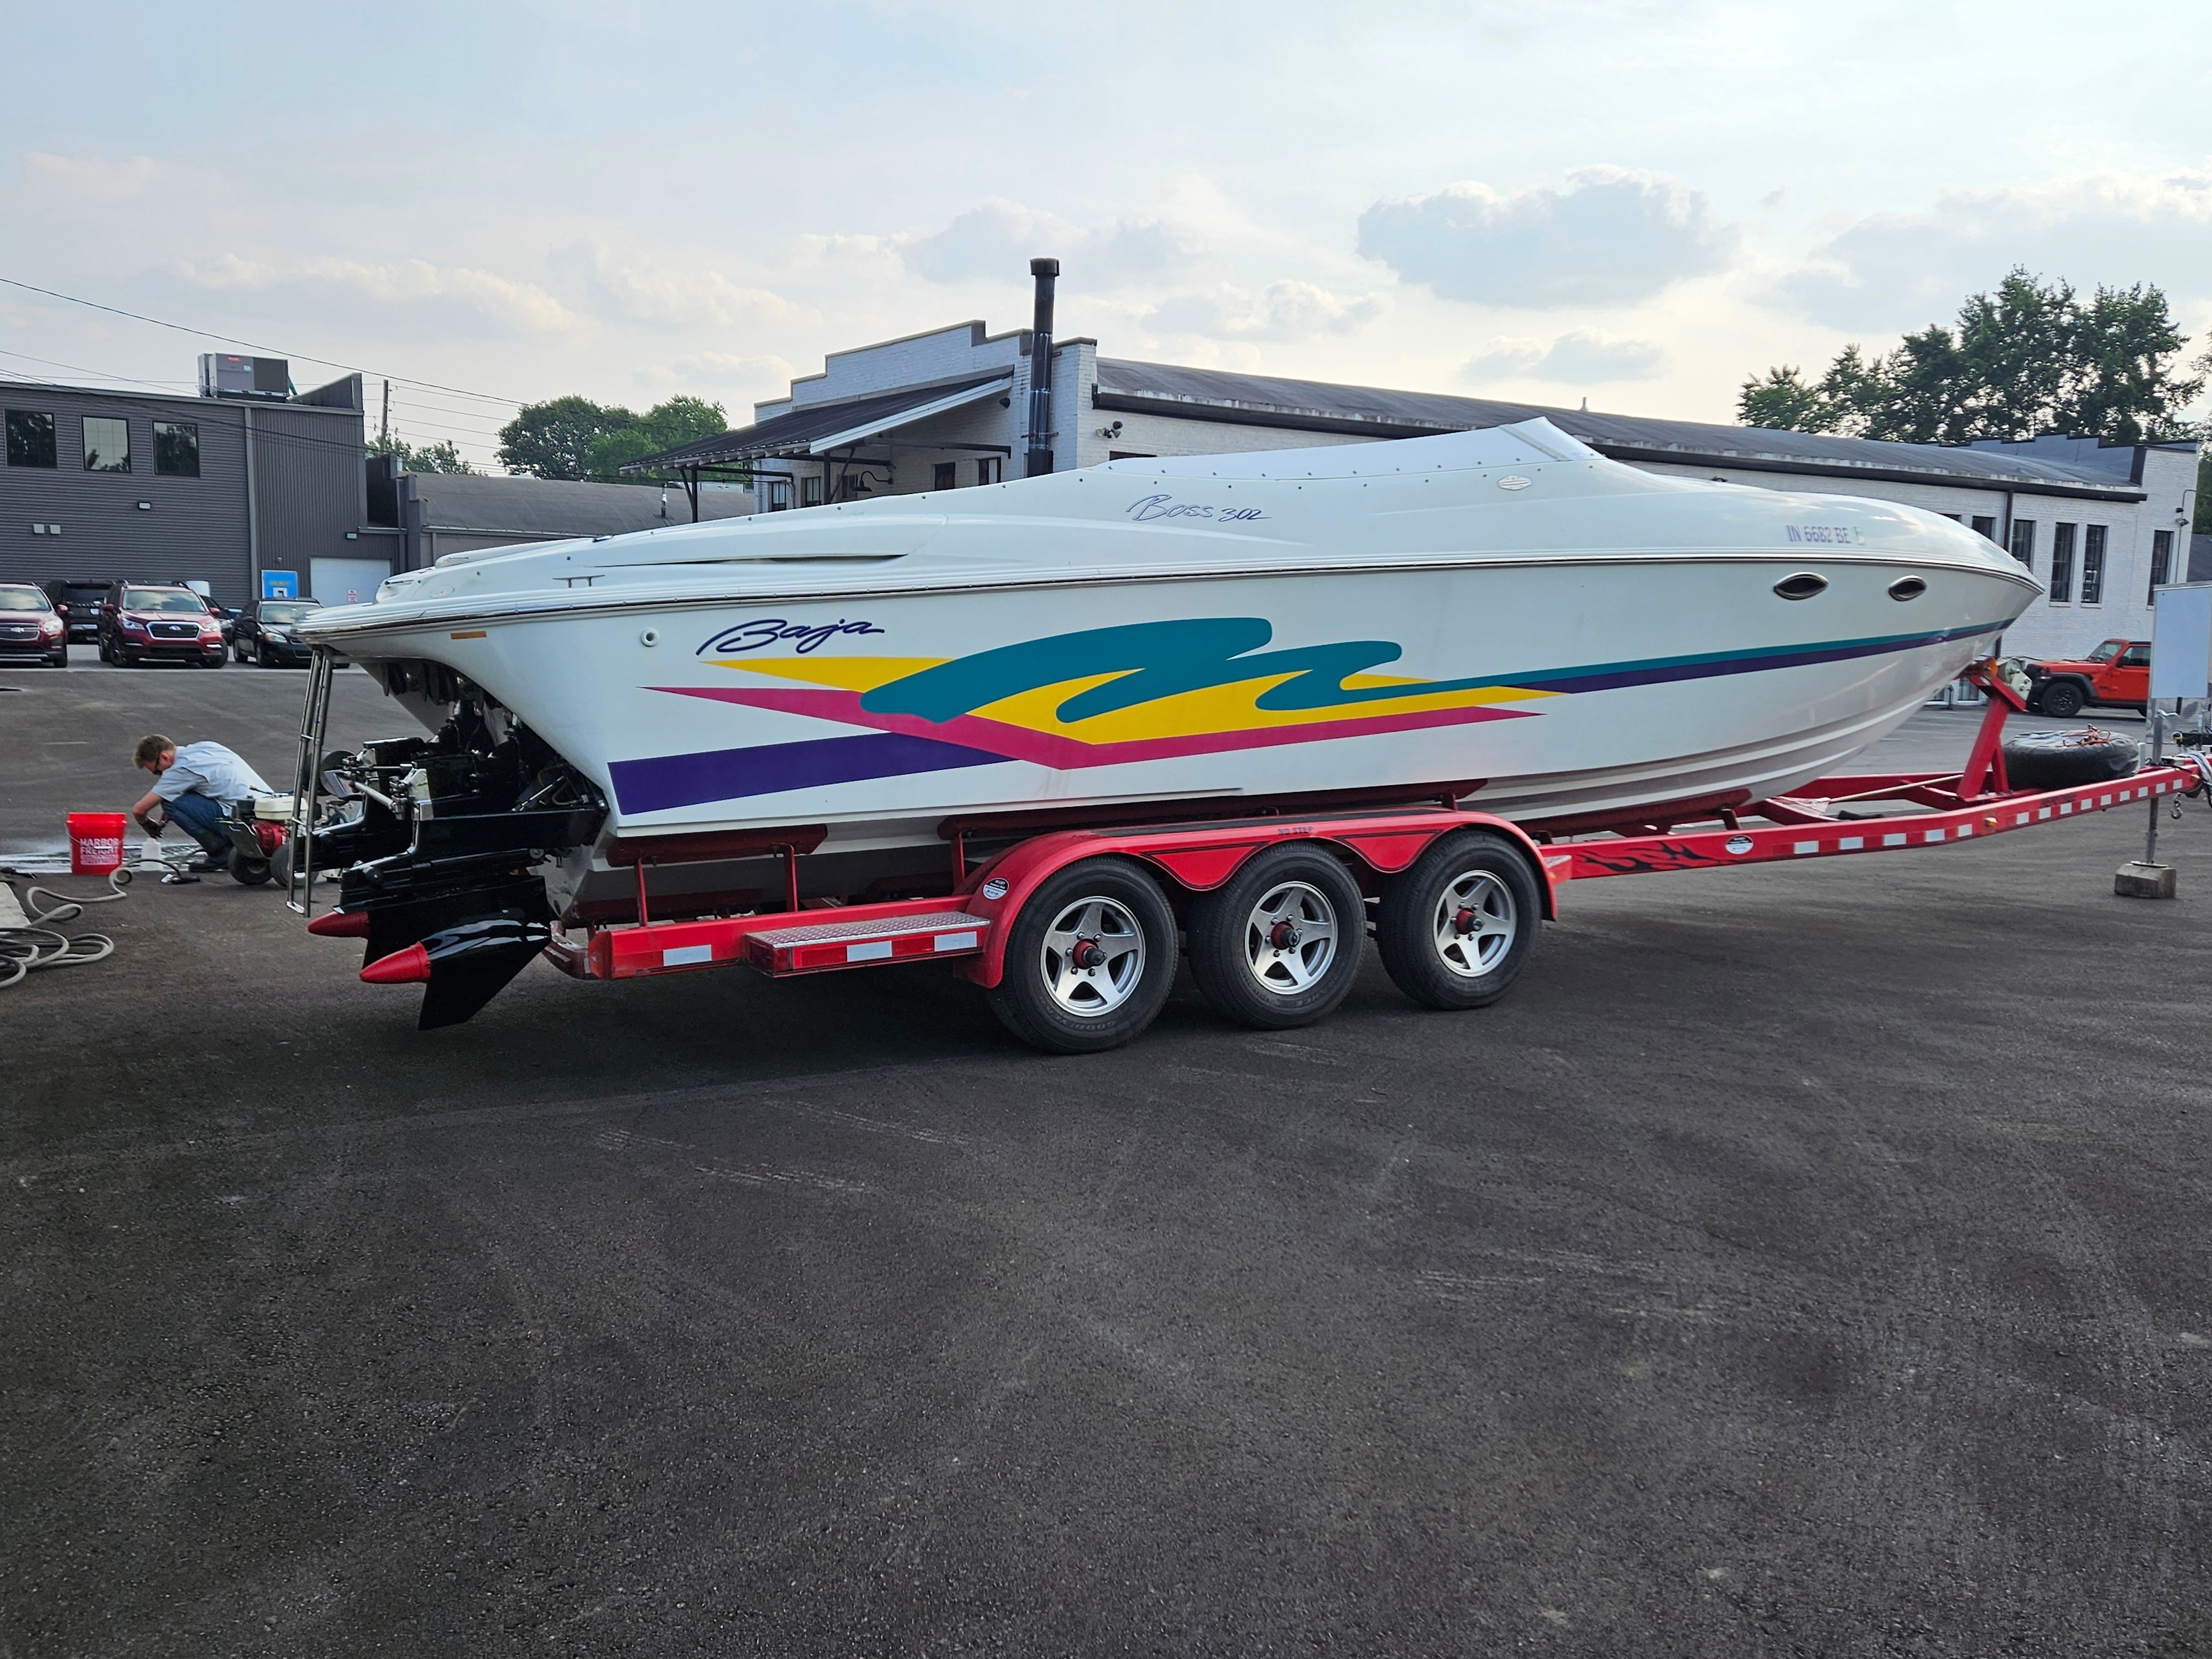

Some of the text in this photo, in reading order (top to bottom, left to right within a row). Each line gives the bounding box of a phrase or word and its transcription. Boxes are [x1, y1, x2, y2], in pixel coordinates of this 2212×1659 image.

[1218, 508, 1272, 522] 302
[1786, 525, 1802, 542] IN
[1804, 526, 1833, 542] 6682
[1834, 527, 1851, 544] BE
[696, 619, 885, 656] Baja
[1292, 826, 1313, 835] STEP
[80, 838, 119, 846] HARBOR
[80, 846, 119, 854] FREIGHT
